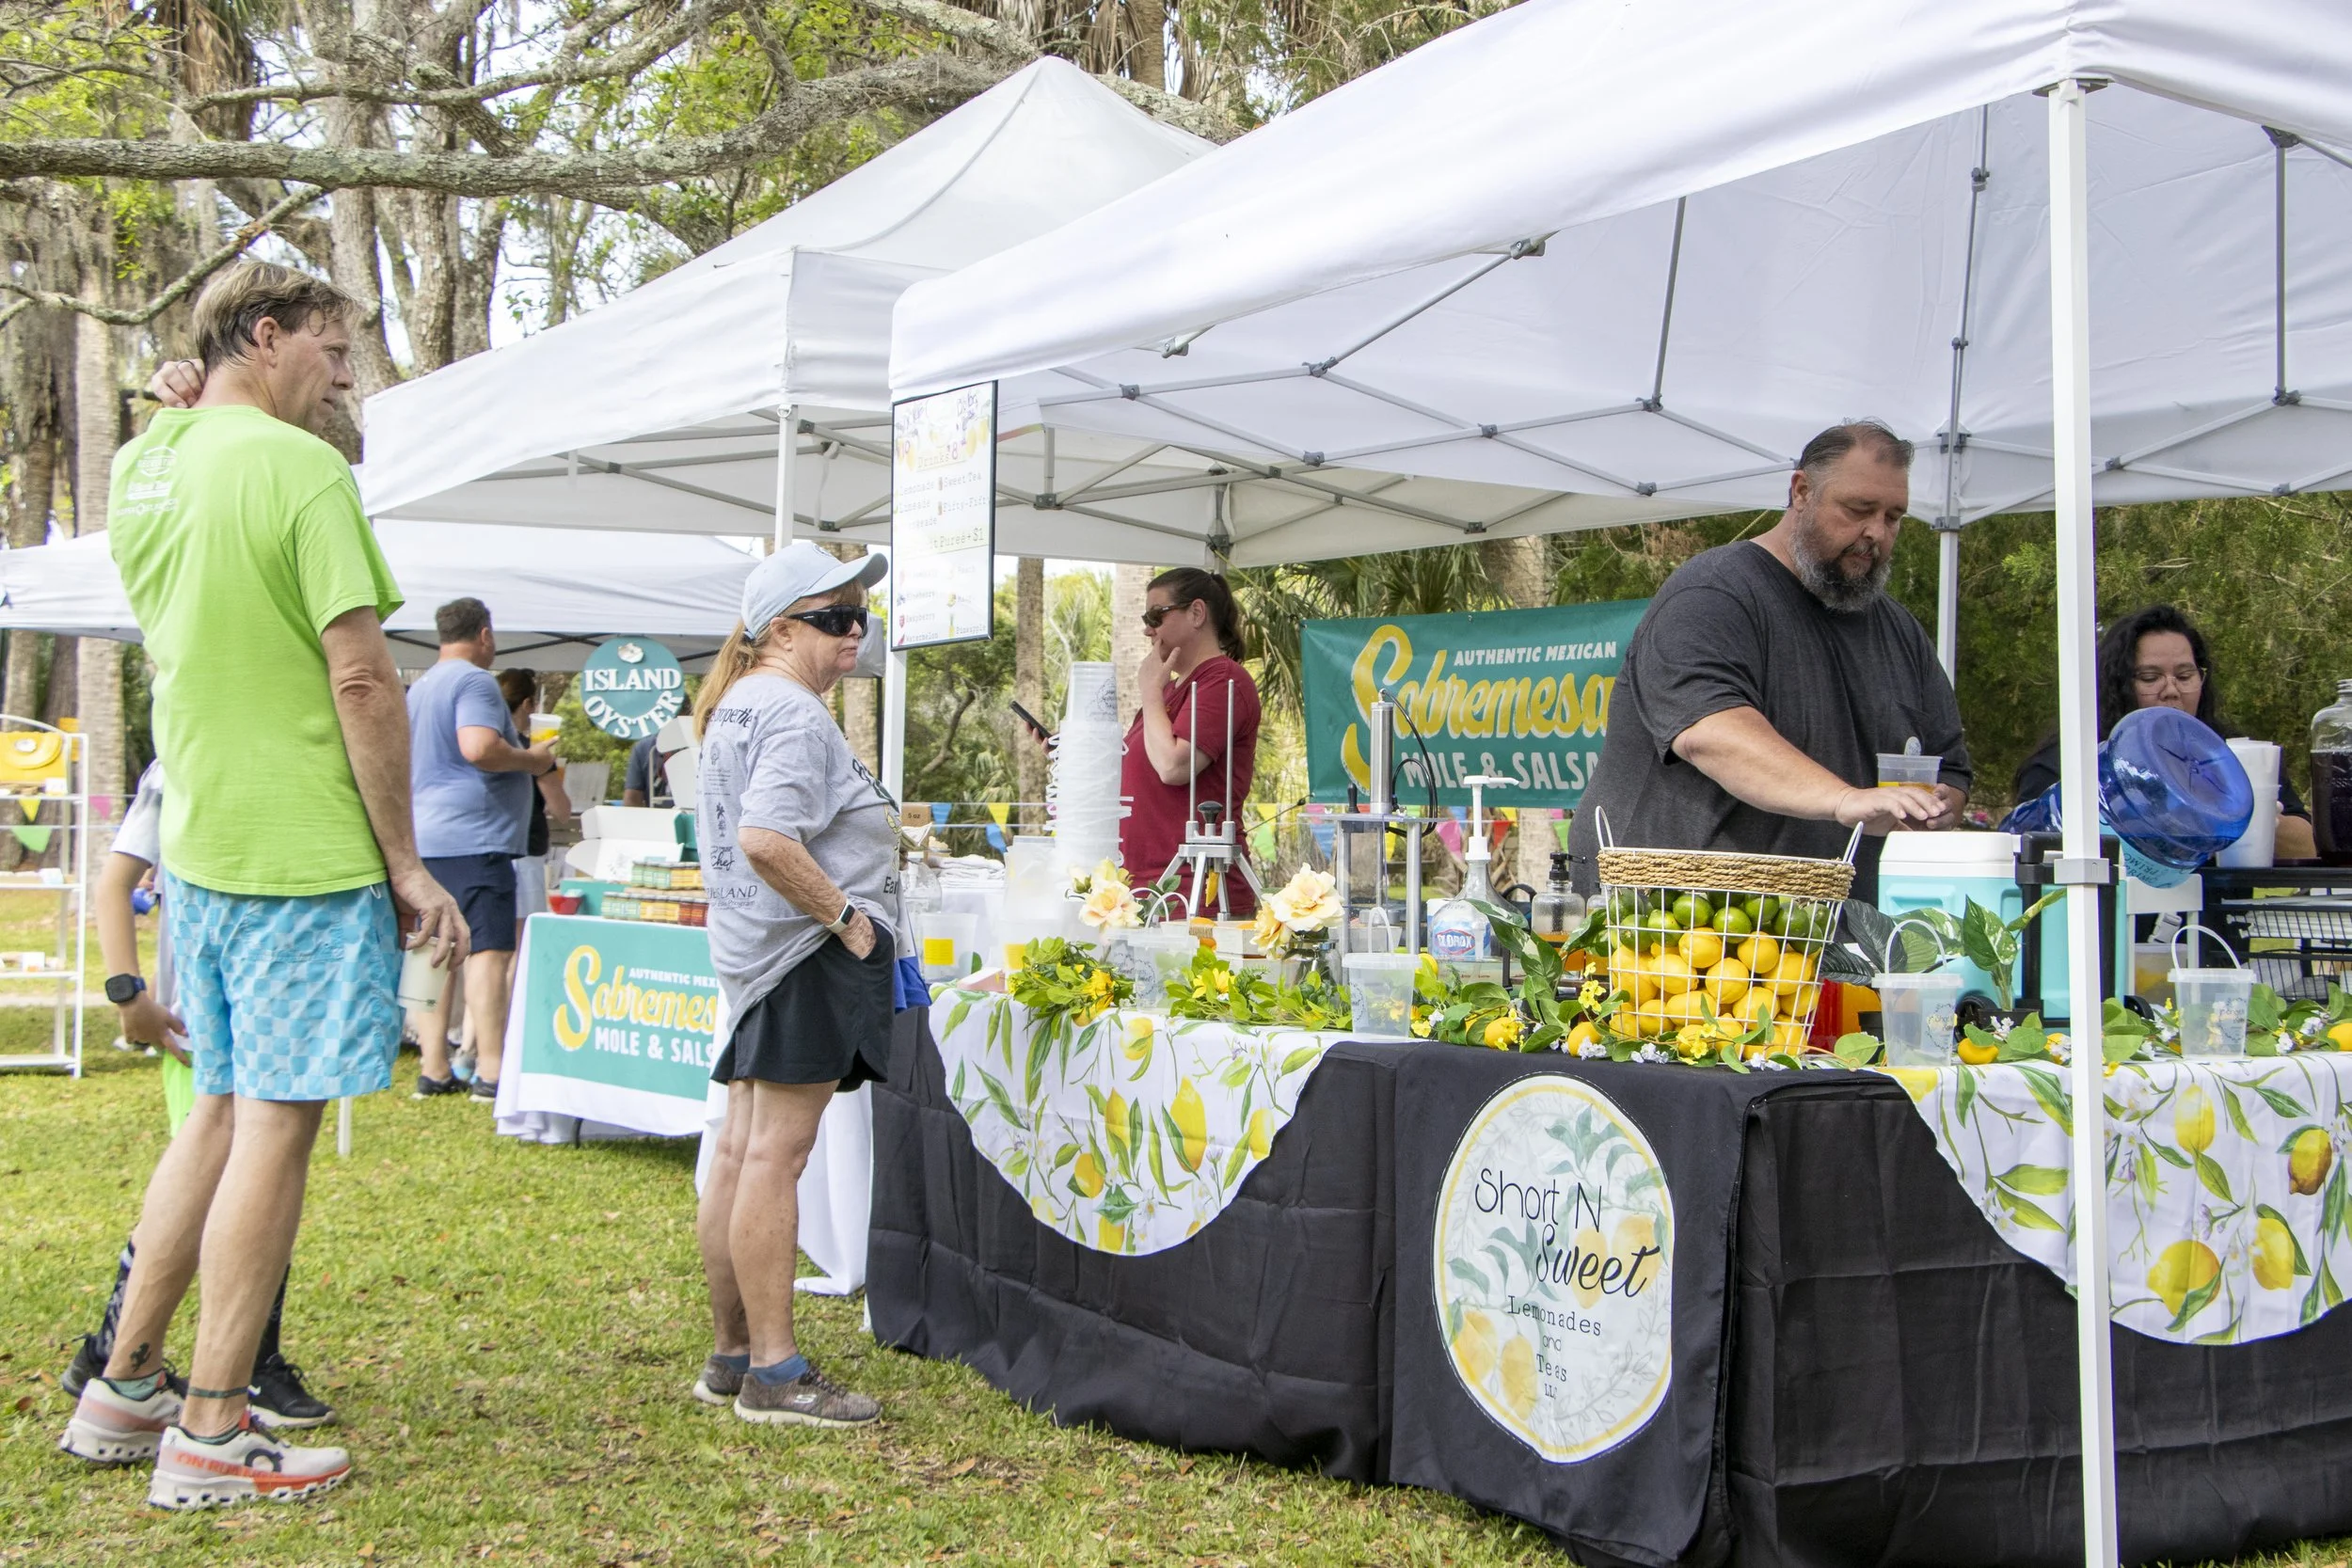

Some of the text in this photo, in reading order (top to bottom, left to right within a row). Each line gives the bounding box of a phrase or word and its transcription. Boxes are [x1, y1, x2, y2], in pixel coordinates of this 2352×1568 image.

[917, 452, 949, 468] Drinks
[944, 474, 966, 487] Sweet
[967, 470, 982, 483] Tea
[1453, 641, 1616, 667] AUTHENTIC MEXICAN
[583, 668, 683, 691] ISLAND
[584, 690, 684, 738] OYSTER
[1401, 752, 1467, 791] MOLE
[629, 968, 690, 985] AUTHENTIC
[595, 1026, 640, 1057] MOLE
[647, 1034, 663, 1060] &
[1474, 1167, 1602, 1233] Short N
[1535, 1224, 1661, 1298] Sweet
[1507, 1295, 1601, 1337] Lemonades
[1536, 1354, 1567, 1383] Teas
